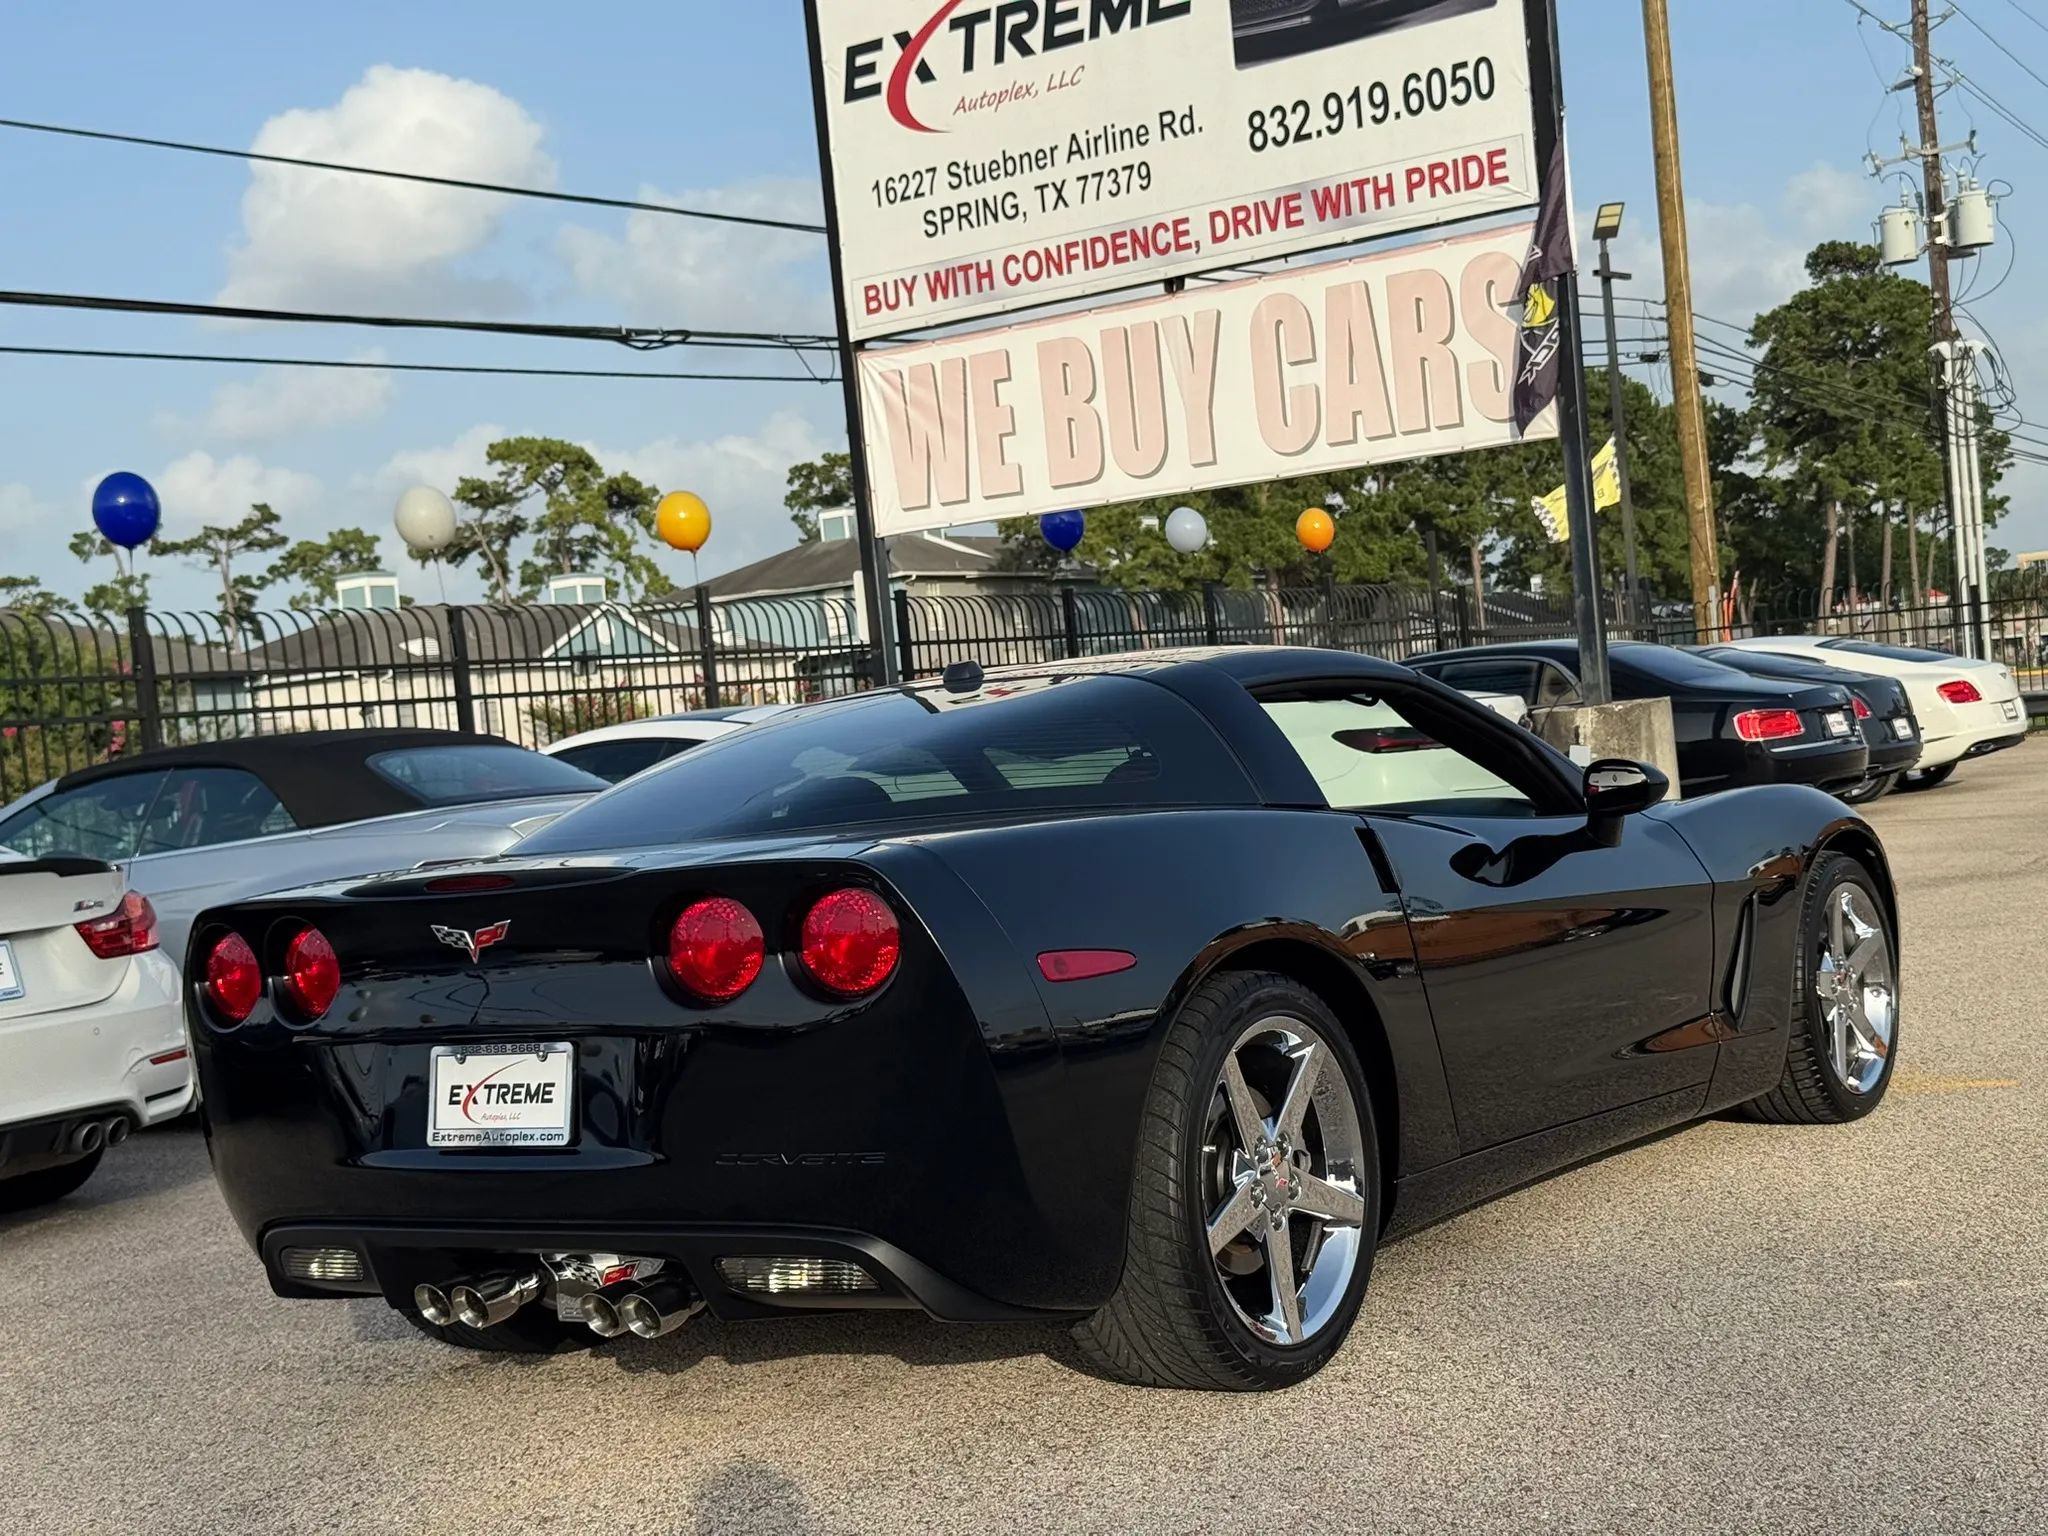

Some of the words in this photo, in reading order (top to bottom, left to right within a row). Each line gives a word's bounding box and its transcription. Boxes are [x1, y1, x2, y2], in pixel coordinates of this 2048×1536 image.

[952, 78, 1039, 115] Autoplex,
[1046, 64, 1086, 92] LLC
[1248, 56, 1495, 152] 832.919.6050
[872, 167, 937, 208] 16227
[947, 144, 1059, 191] Stuebner
[1066, 124, 1150, 164] Airline
[1158, 105, 1204, 142] Rd.
[864, 276, 918, 316] BUY
[924, 260, 995, 302] WITH
[1002, 217, 1201, 287] CONFIDENCE,
[1209, 193, 1304, 245] DRIVE
[1311, 173, 1395, 222] WITH
[1405, 148, 1510, 203] PRIDE
[923, 192, 1028, 239] SPRING,
[1034, 180, 1070, 214] TX
[1076, 161, 1152, 204] 77379
[880, 348, 1025, 511] WE
[1036, 308, 1222, 490] BUY
[1249, 250, 1522, 457] CARS
[448, 1082, 556, 1106] EXTREME
[432, 1131, 565, 1144] ExtremeAutoplex.com
[714, 1151, 887, 1166] CORVETTE
